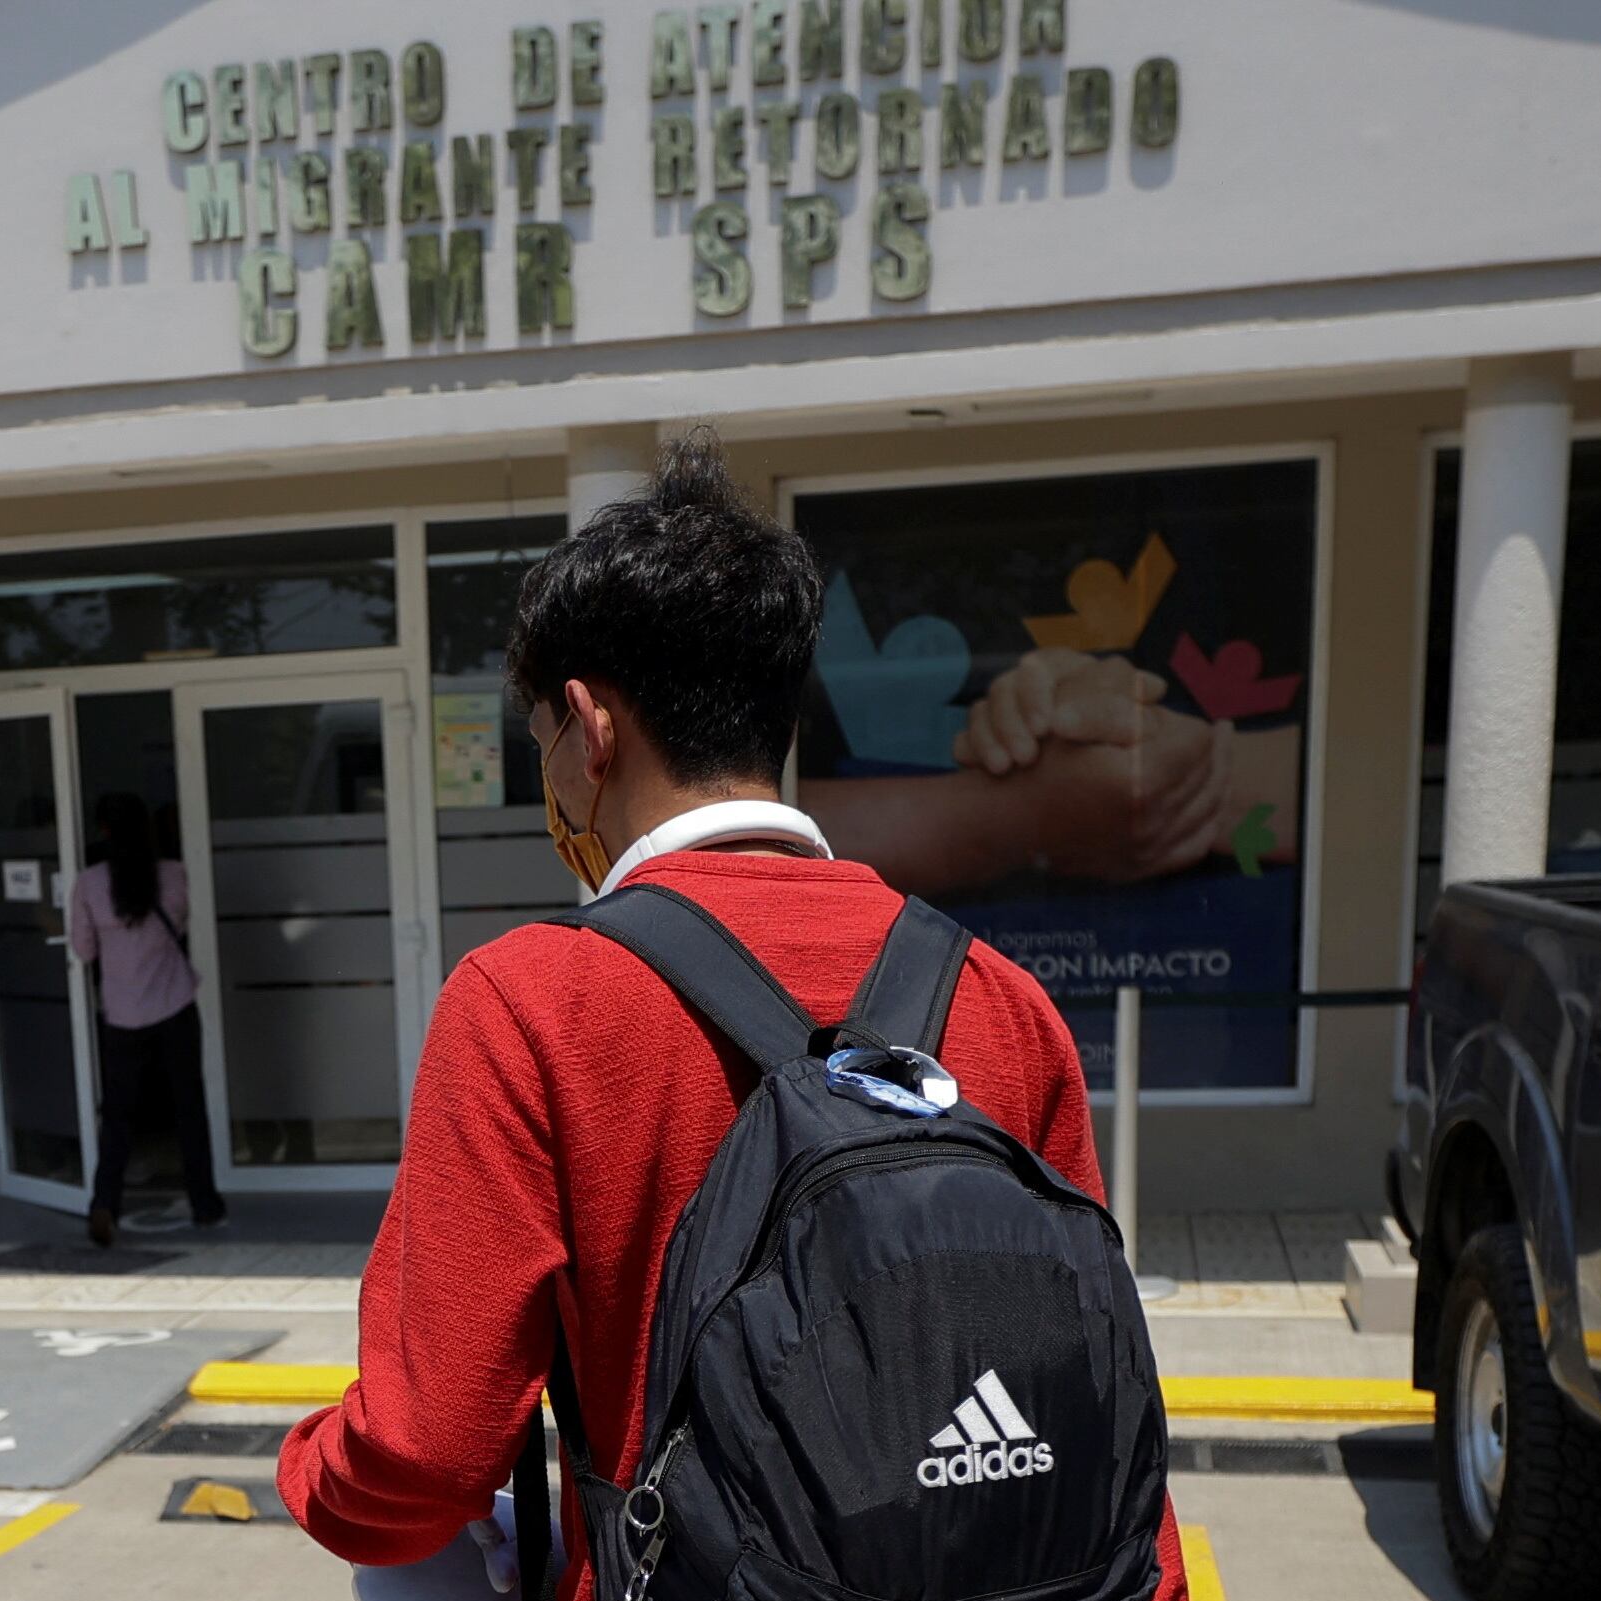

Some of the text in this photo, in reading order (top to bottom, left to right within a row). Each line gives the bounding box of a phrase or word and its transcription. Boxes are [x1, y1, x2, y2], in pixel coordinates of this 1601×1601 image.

[162, 41, 444, 154] CENTRO
[512, 20, 606, 112] DE
[66, 57, 1179, 254] AL MIGRANTE RETORNADO
[240, 183, 932, 358] CAMR SPS
[1090, 949, 1232, 979] IMPACTO
[917, 1440, 1055, 1488] adidas
